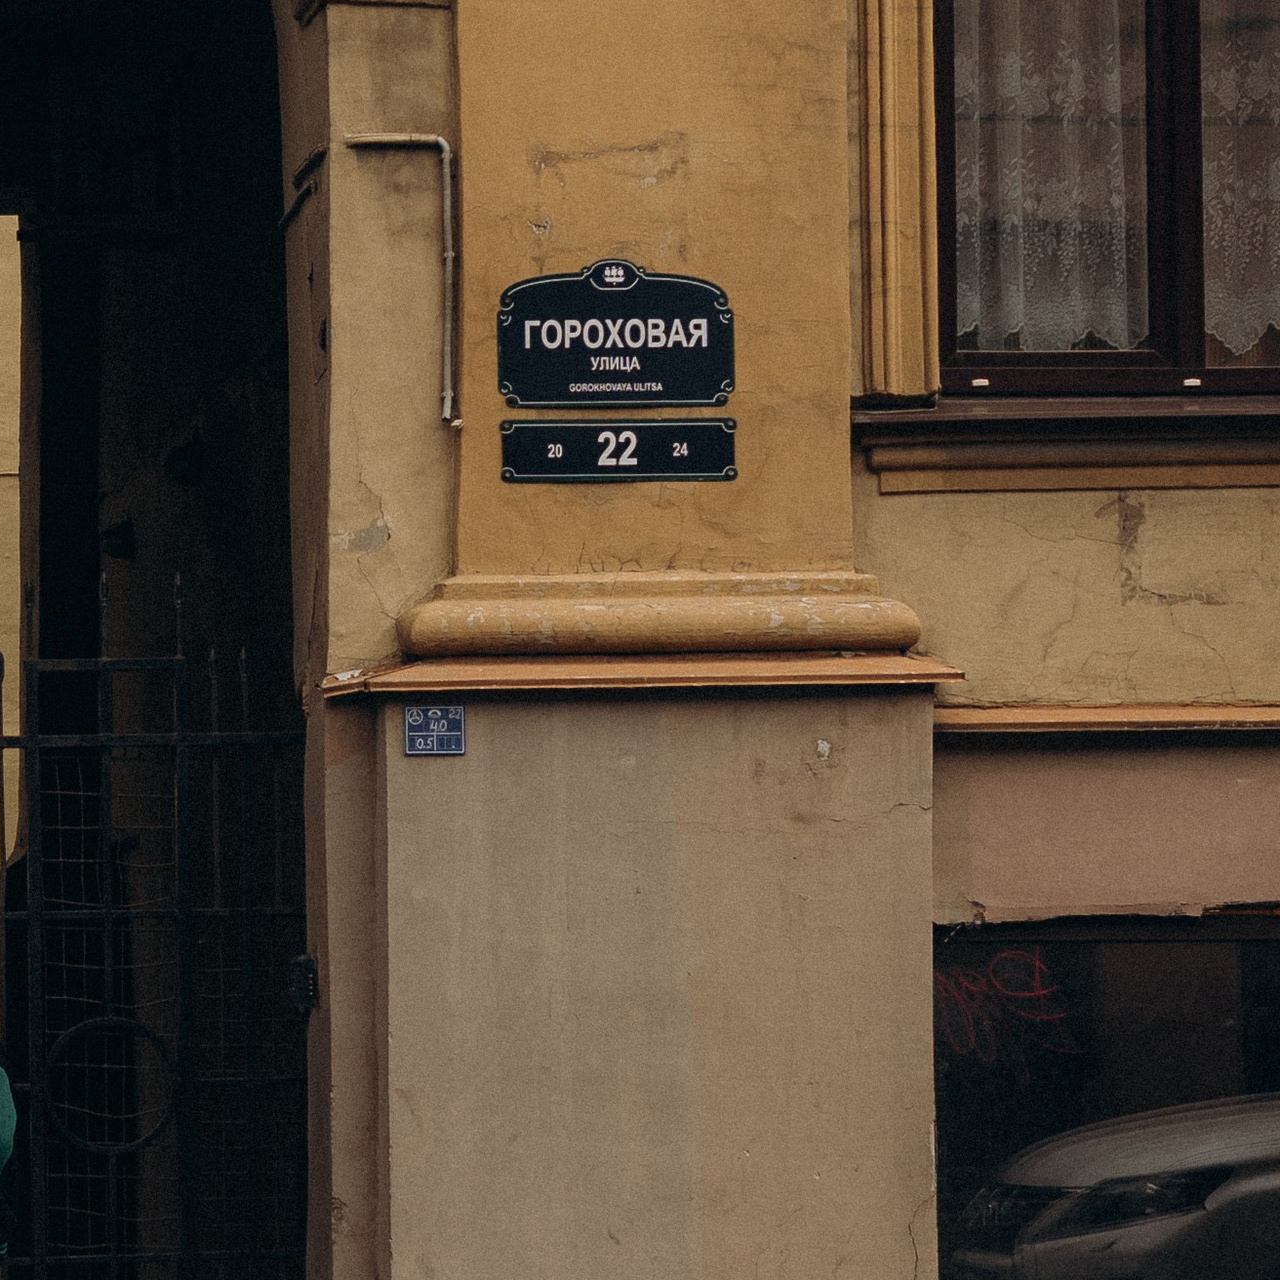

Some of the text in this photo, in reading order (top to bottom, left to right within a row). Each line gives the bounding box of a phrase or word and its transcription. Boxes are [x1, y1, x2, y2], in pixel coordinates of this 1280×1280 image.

[524, 318, 708, 349] ГОРОХОВАЯ
[590, 356, 640, 372] УЛИЦА
[569, 382, 663, 392] GOROKHOVAYA ULITSA
[547, 431, 688, 466] 20 22 24
[416, 737, 434, 750] 0.5
